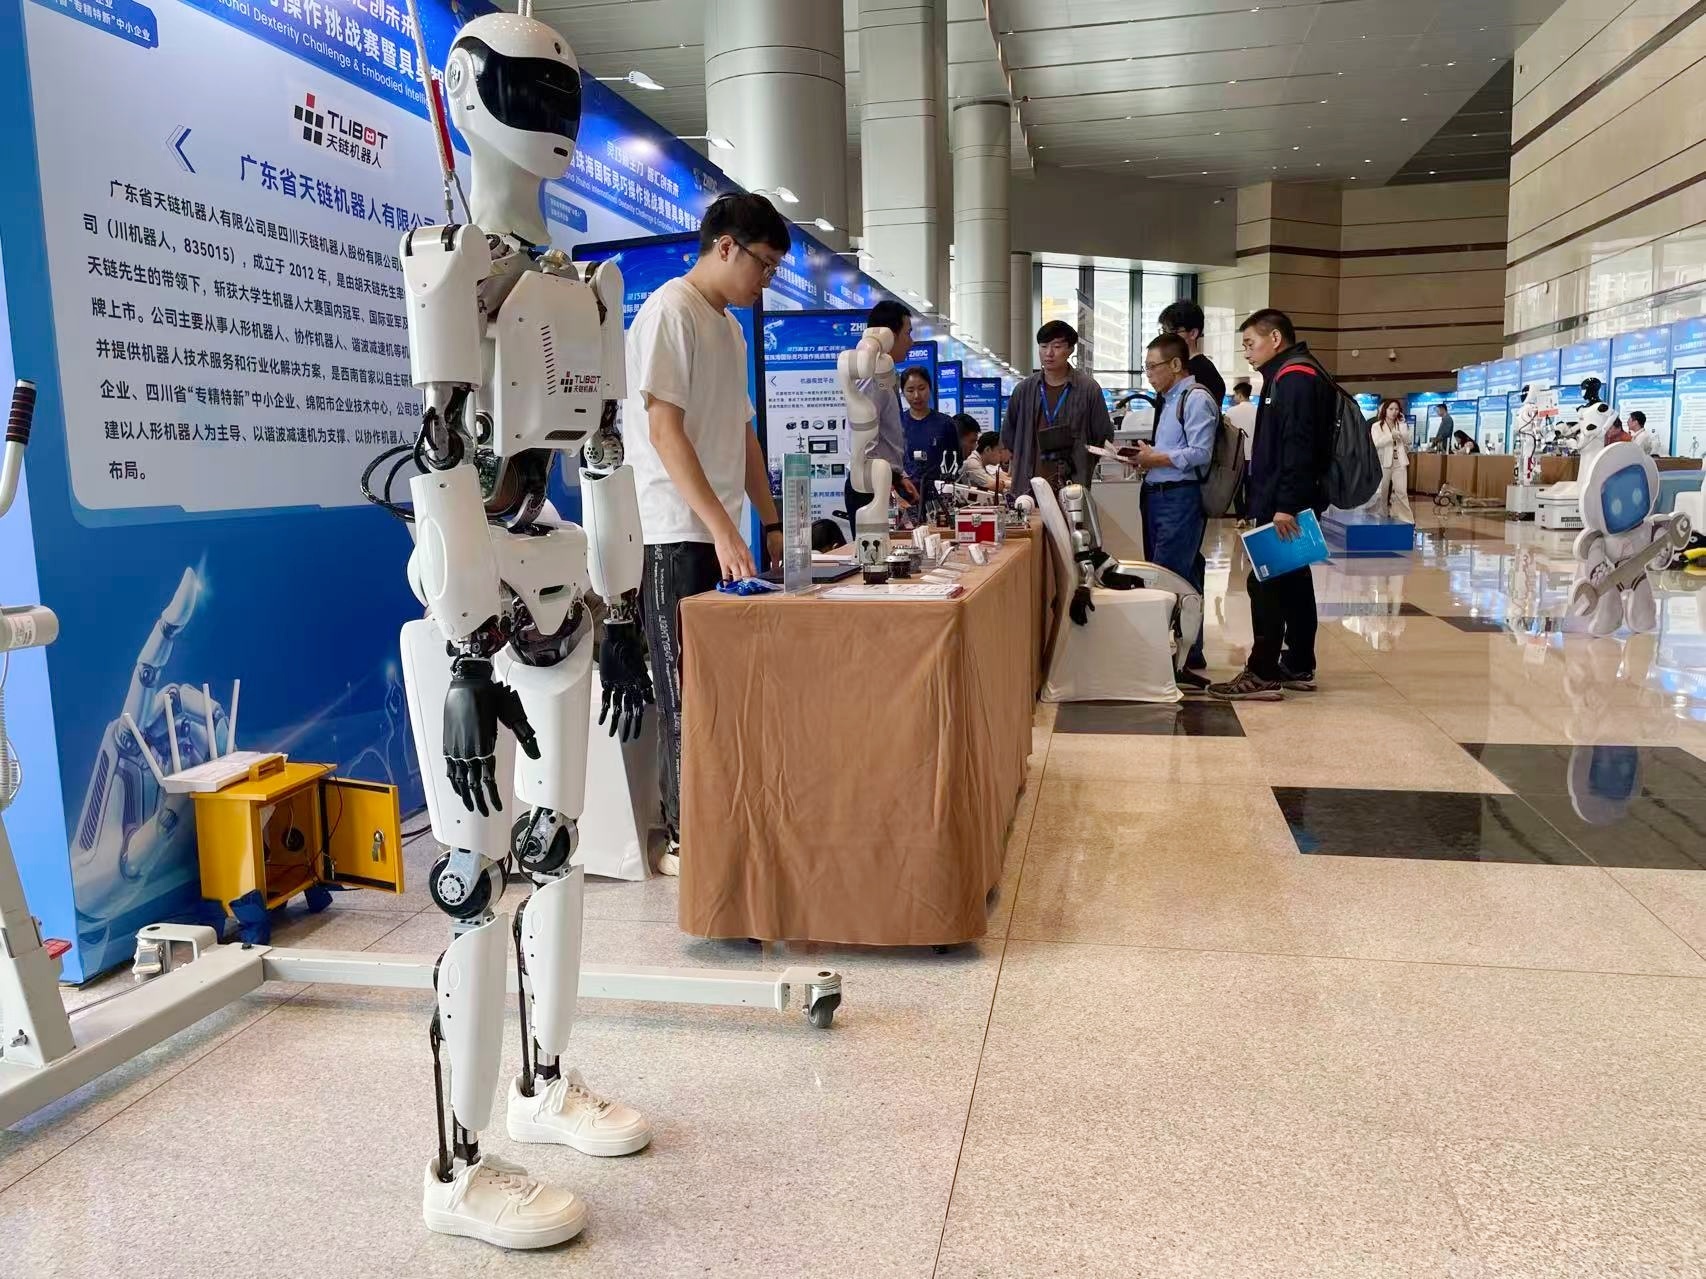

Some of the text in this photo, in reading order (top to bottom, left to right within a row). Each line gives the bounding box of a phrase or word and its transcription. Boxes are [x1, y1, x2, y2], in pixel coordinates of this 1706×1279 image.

[218, 0, 250, 16] onal
[253, 7, 300, 44] Dexterity
[302, 33, 351, 68] Challenge
[353, 58, 360, 72] &
[361, 61, 403, 93] Embodied
[270, 0, 444, 96] 操作挑战赛暨具身智
[326, 133, 382, 168] 天链机器人
[569, 149, 701, 232] 珠海国际灵巧操作挑战赛暨具身智能
[289, 262, 315, 281] 2012
